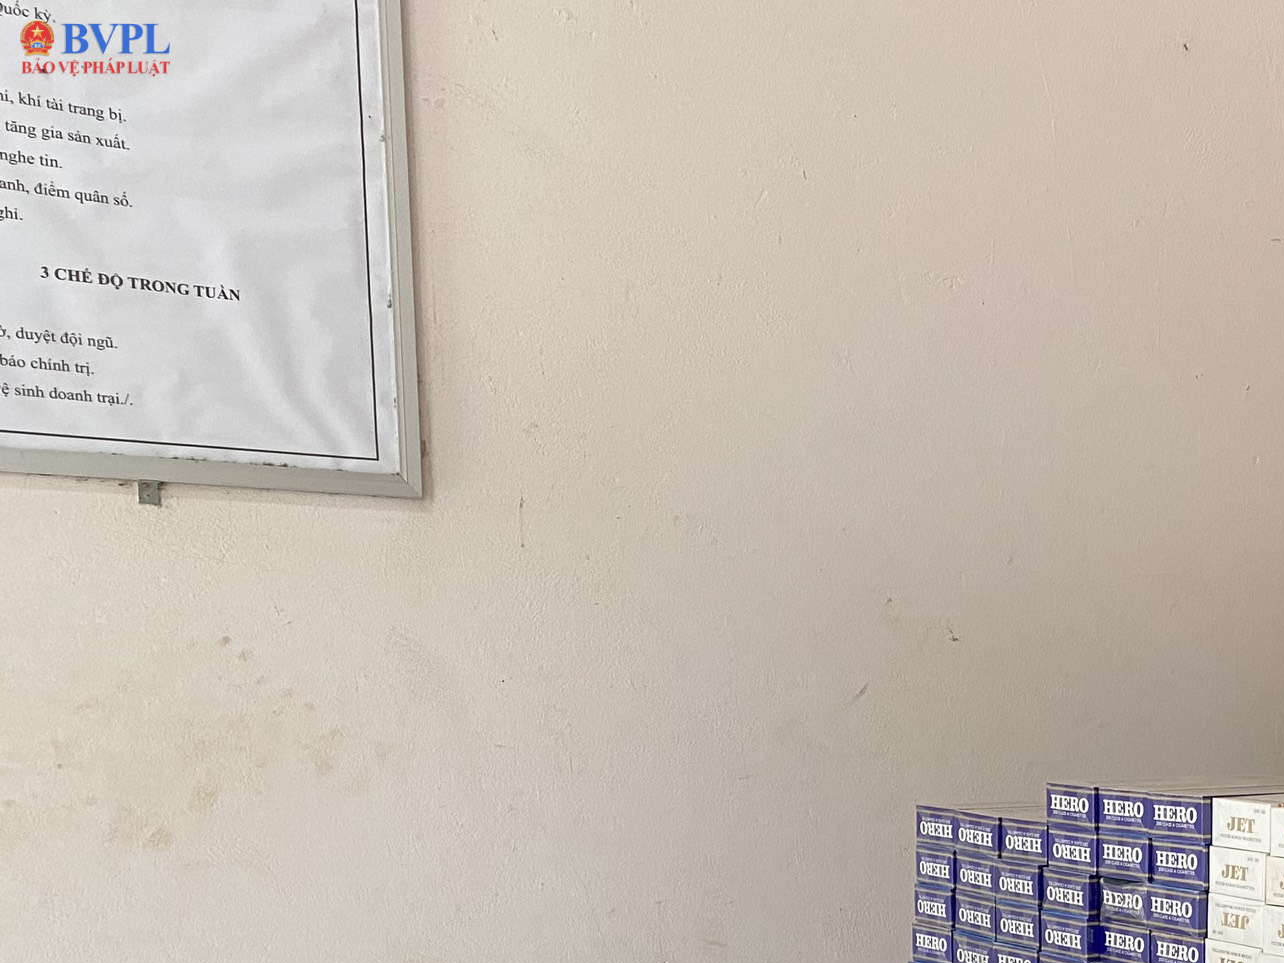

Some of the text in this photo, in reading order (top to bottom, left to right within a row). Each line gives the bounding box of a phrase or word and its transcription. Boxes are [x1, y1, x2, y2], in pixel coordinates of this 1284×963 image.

[46, 98, 63, 111] tài
[68, 103, 105, 121] trang
[109, 107, 126, 123] bị.
[5, 120, 130, 150] tăng gia sản xuất.
[0, 151, 63, 168] nghe tin.
[34, 181, 70, 199] điểm
[74, 191, 109, 204] quân
[113, 191, 133, 208] số.
[40, 266, 49, 278] 3
[98, 273, 123, 290] ĐỘ
[127, 276, 190, 296] TRONG
[15, 327, 56, 344] duyệt
[60, 331, 83, 347] đội
[87, 336, 118, 351] ngũ.
[0, 353, 95, 377] báo chính trị.
[14, 384, 45, 399] sinh
[49, 387, 93, 403] doanh
[1050, 793, 1089, 814] HERO
[1103, 798, 1144, 820] HERO
[1153, 804, 1198, 825] HERO
[919, 820, 953, 840] HERO
[1227, 815, 1255, 834] JET
[958, 826, 992, 848] HERO
[1005, 833, 1042, 854] HERO
[1053, 841, 1091, 863] HERO
[1103, 844, 1143, 865] HERO
[1156, 850, 1198, 872] HERO
[1222, 864, 1249, 882] JET
[1151, 896, 1193, 919] HERO
[916, 933, 948, 953] HERO
[1105, 931, 1145, 954] HERO
[1156, 940, 1199, 963] HERO
